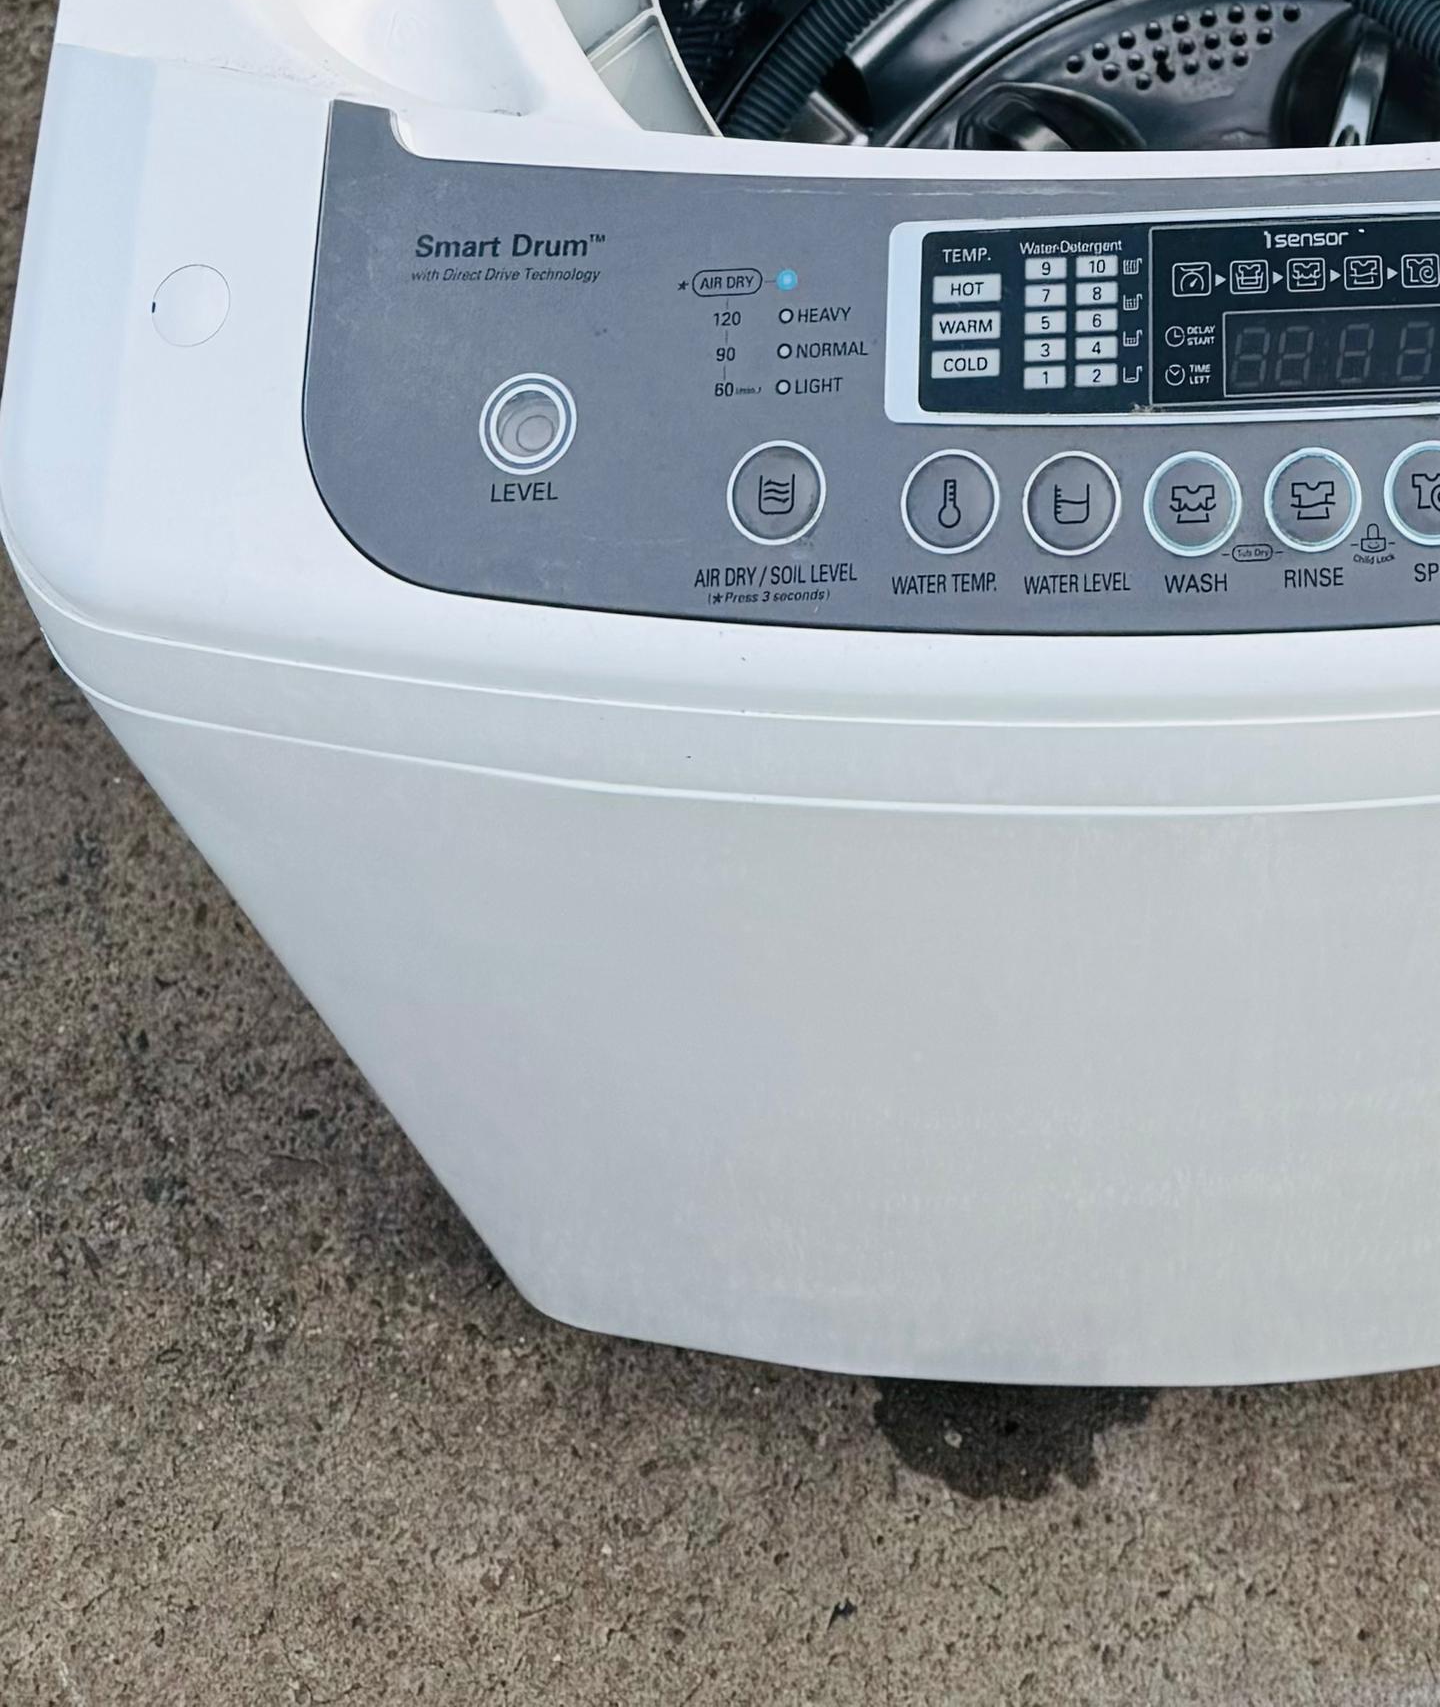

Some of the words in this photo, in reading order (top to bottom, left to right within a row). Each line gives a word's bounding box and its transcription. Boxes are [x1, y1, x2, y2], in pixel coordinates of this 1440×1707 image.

[415, 234, 502, 258] Smart
[942, 247, 992, 263] TEMP.
[1040, 261, 1052, 276] 9
[1088, 258, 1107, 274] 10
[411, 268, 440, 281] with
[442, 268, 483, 281] Direct
[484, 267, 521, 281] Drive
[525, 267, 601, 283] Technology
[699, 277, 723, 291] AIR
[726, 275, 755, 289] DRY
[950, 281, 985, 297] HOT
[1041, 288, 1051, 303] 7
[1091, 286, 1103, 302] 8
[713, 310, 742, 327] 120
[797, 305, 852, 323] HEAVY
[1091, 313, 1103, 328] 6
[939, 318, 994, 335] WARM
[1040, 315, 1051, 330] 5
[1186, 324, 1216, 335] DELAY
[715, 346, 736, 362] 90
[795, 340, 869, 359] NORMAL
[1039, 342, 1051, 358] 3
[1090, 340, 1102, 355] 4
[942, 356, 989, 372] COLD
[1188, 363, 1212, 374] TIME
[1042, 370, 1049, 385] 1
[1091, 368, 1102, 383] 2
[1189, 374, 1211, 385] LEFT
[794, 376, 844, 395] LIGHT
[490, 481, 559, 503] LEVEL
[694, 567, 721, 588] AIR
[724, 565, 757, 587] DRY
[770, 564, 807, 586] SOIL
[810, 562, 858, 584] LEVEL
[1023, 573, 1079, 595] WATER
[1083, 571, 1131, 593] LEVEL
[1164, 572, 1228, 594] WASH
[1284, 567, 1345, 588] RINSE
[891, 574, 947, 596] WATER
[950, 571, 998, 594] TEMP.
[761, 590, 771, 603] 3
[772, 588, 831, 603] seconds)
